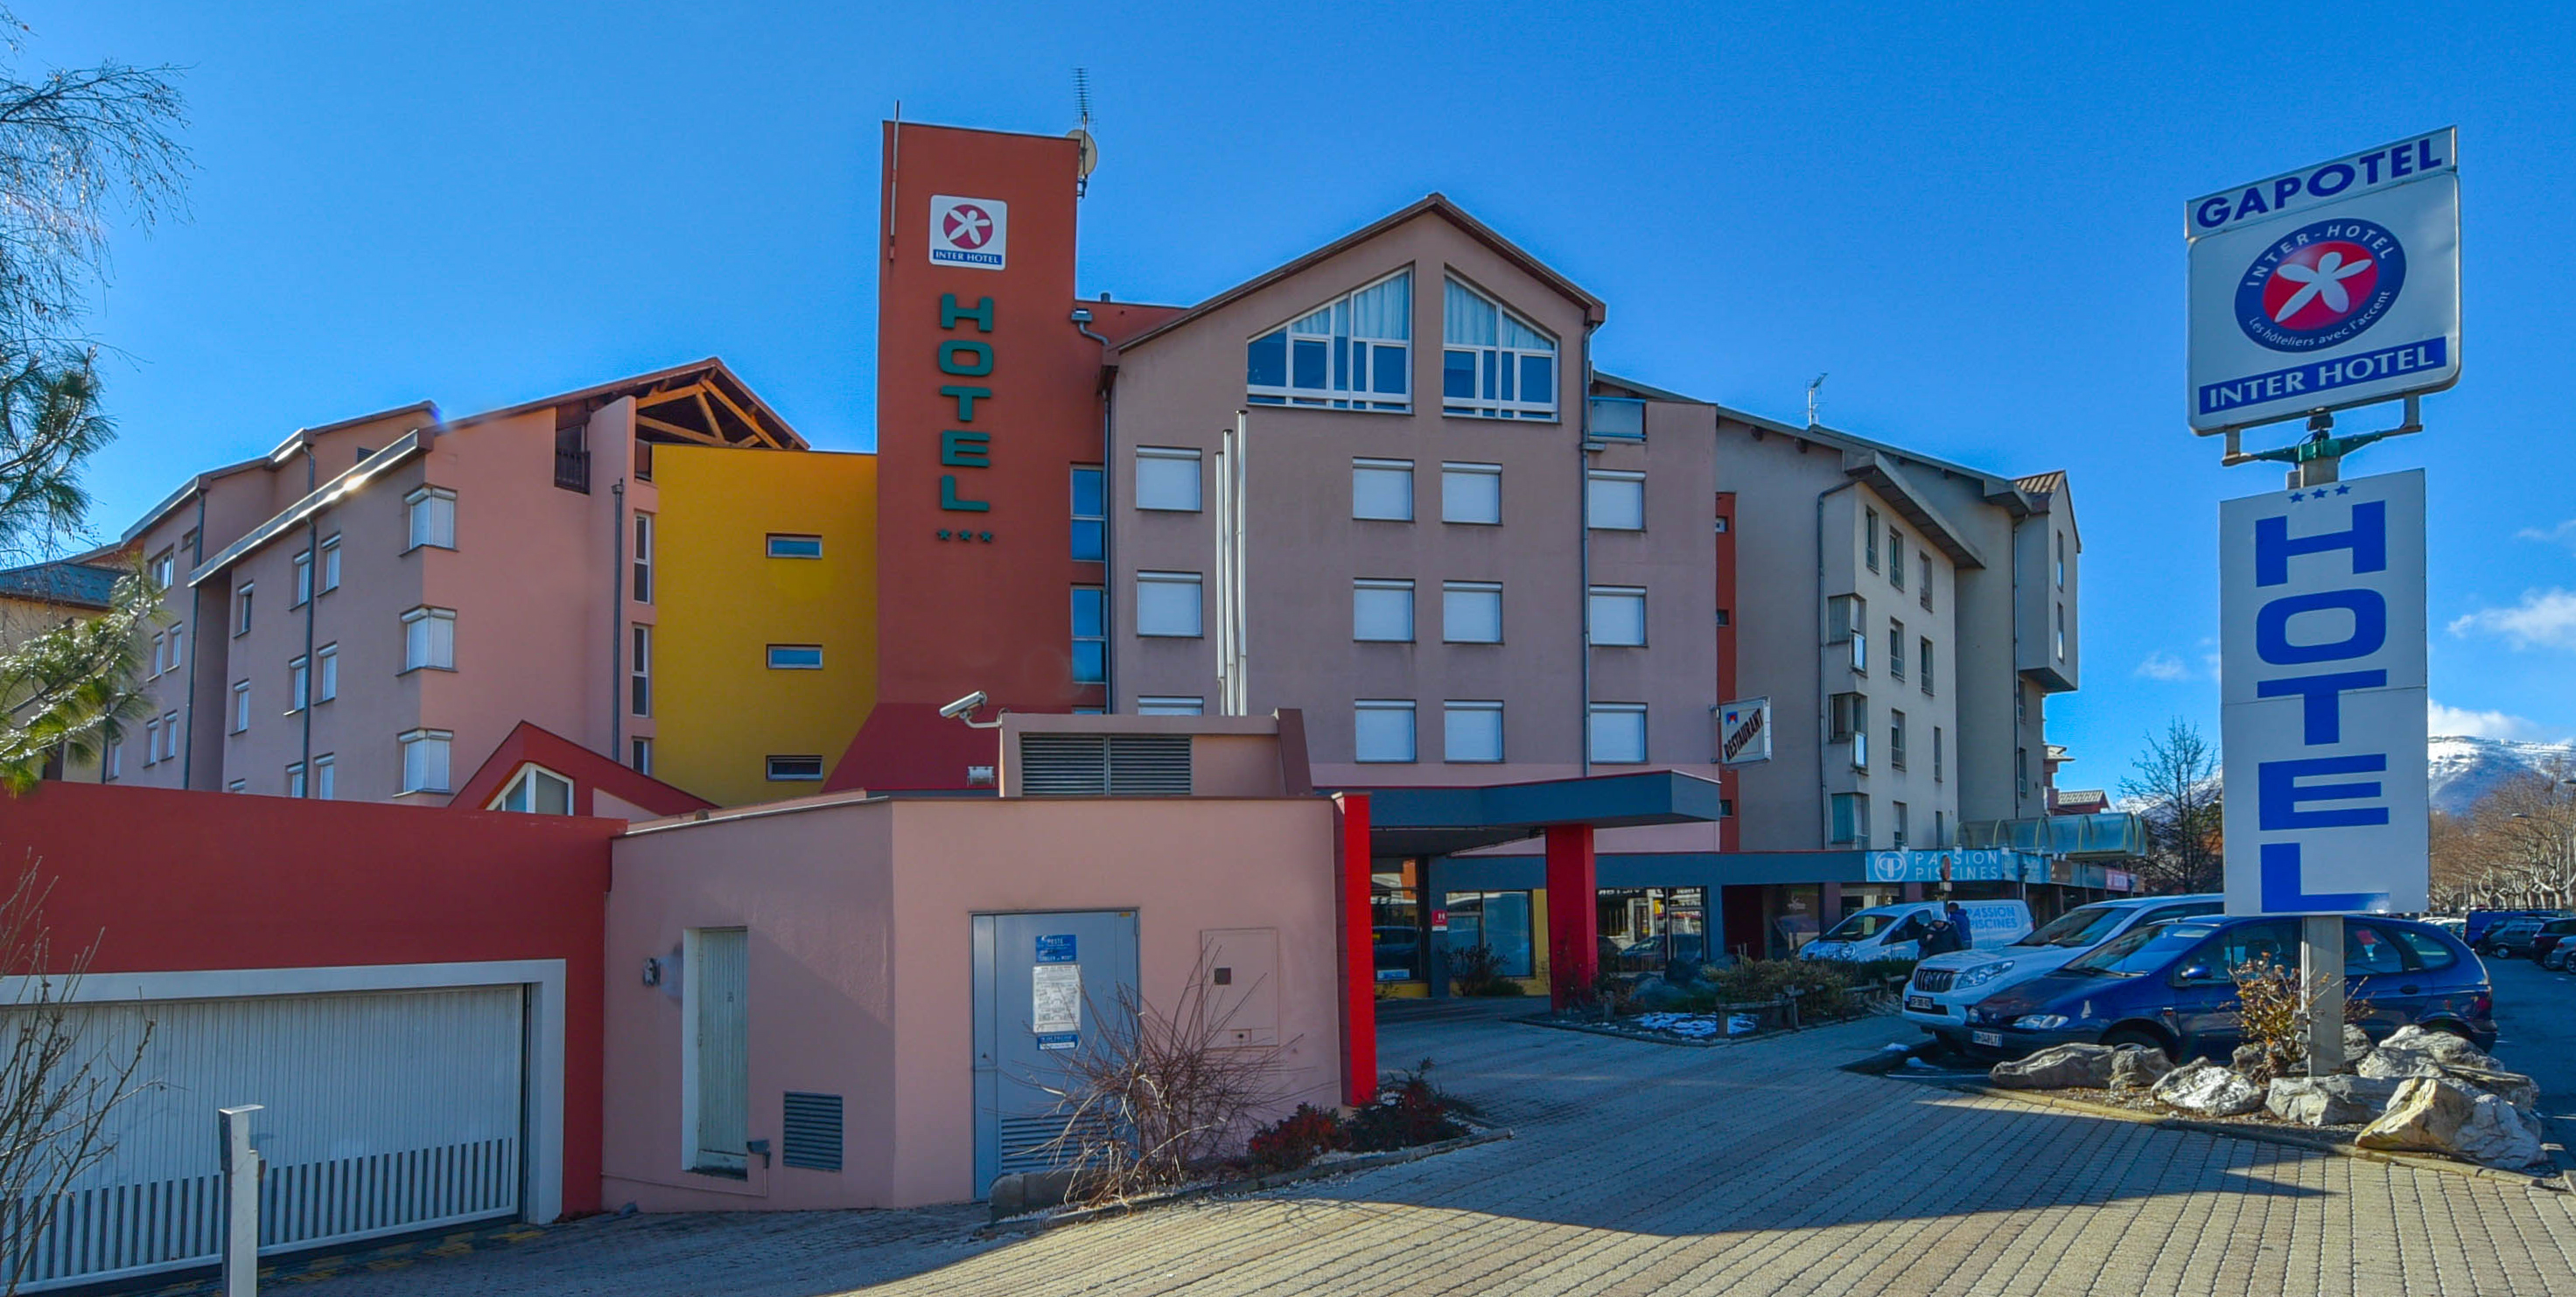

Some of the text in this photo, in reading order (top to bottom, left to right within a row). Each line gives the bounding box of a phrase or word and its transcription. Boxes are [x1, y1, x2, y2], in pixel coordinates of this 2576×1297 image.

[2196, 138, 2442, 228] GAPOTEL
[935, 250, 998, 263] INTER HOTEL
[2246, 224, 2395, 287] INTER-HOTEL
[2249, 291, 2391, 347] Les hôteliers avec l'accent
[938, 293, 994, 512] HOTEL
[2209, 345, 2434, 409] INTER HOTEL
[1724, 707, 1764, 762] RESTAURANT
[2255, 499, 2390, 914] HOTEL
[1915, 852, 1998, 866] PASION
